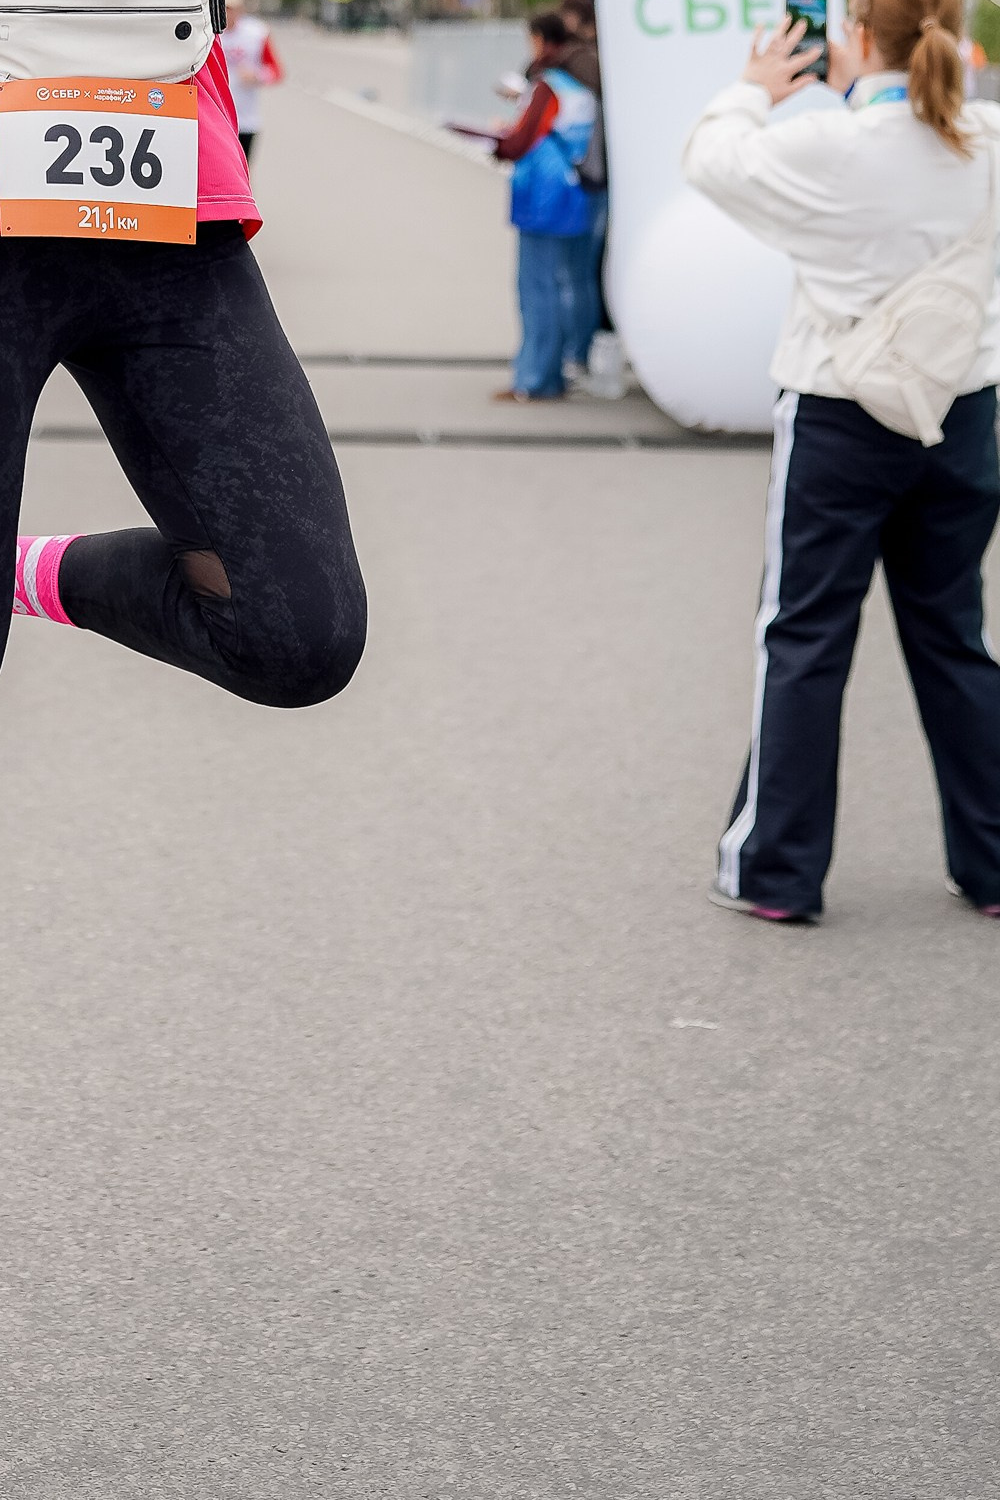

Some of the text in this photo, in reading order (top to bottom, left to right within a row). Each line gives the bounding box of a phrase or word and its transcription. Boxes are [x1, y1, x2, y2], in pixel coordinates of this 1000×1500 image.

[51, 89, 81, 99] СБЕР
[44, 123, 163, 190] 236
[78, 206, 115, 233] 21,1
